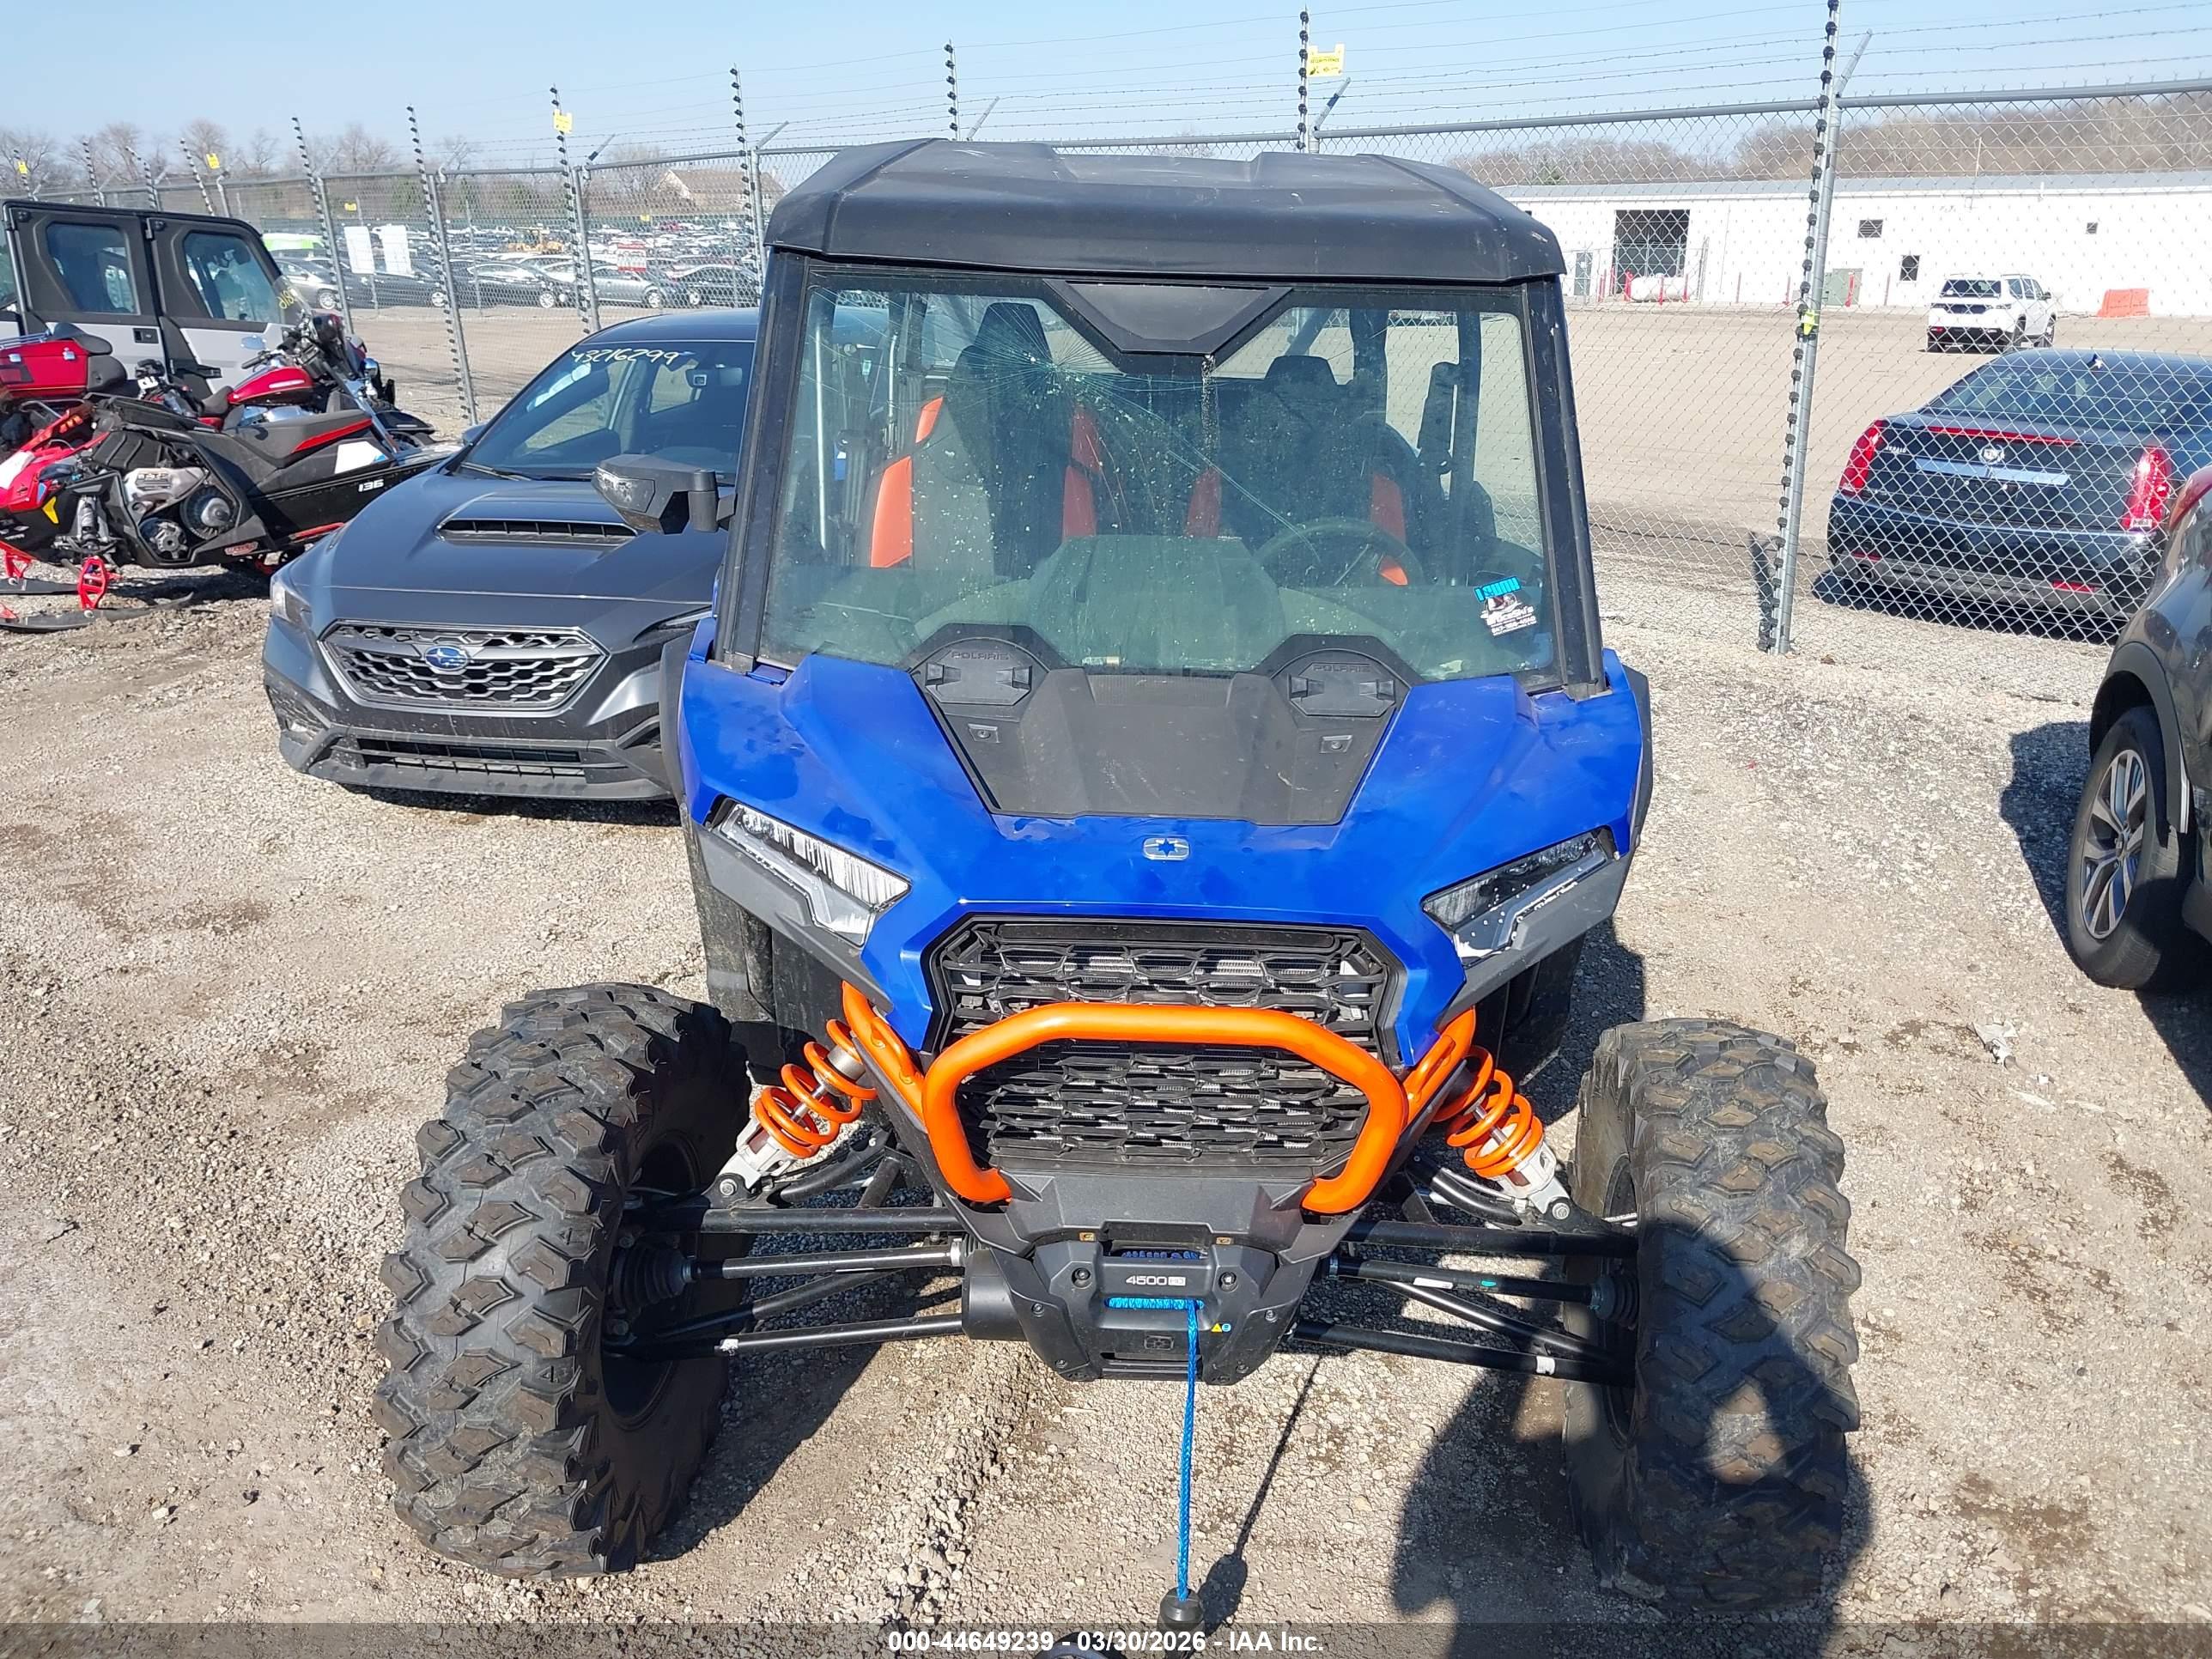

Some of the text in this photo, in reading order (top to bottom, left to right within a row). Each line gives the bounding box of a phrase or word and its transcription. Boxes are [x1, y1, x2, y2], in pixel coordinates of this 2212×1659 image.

[358, 478, 385, 492] 136
[951, 652, 1009, 660] POLARIS
[1125, 1275, 1167, 1285] 4500
